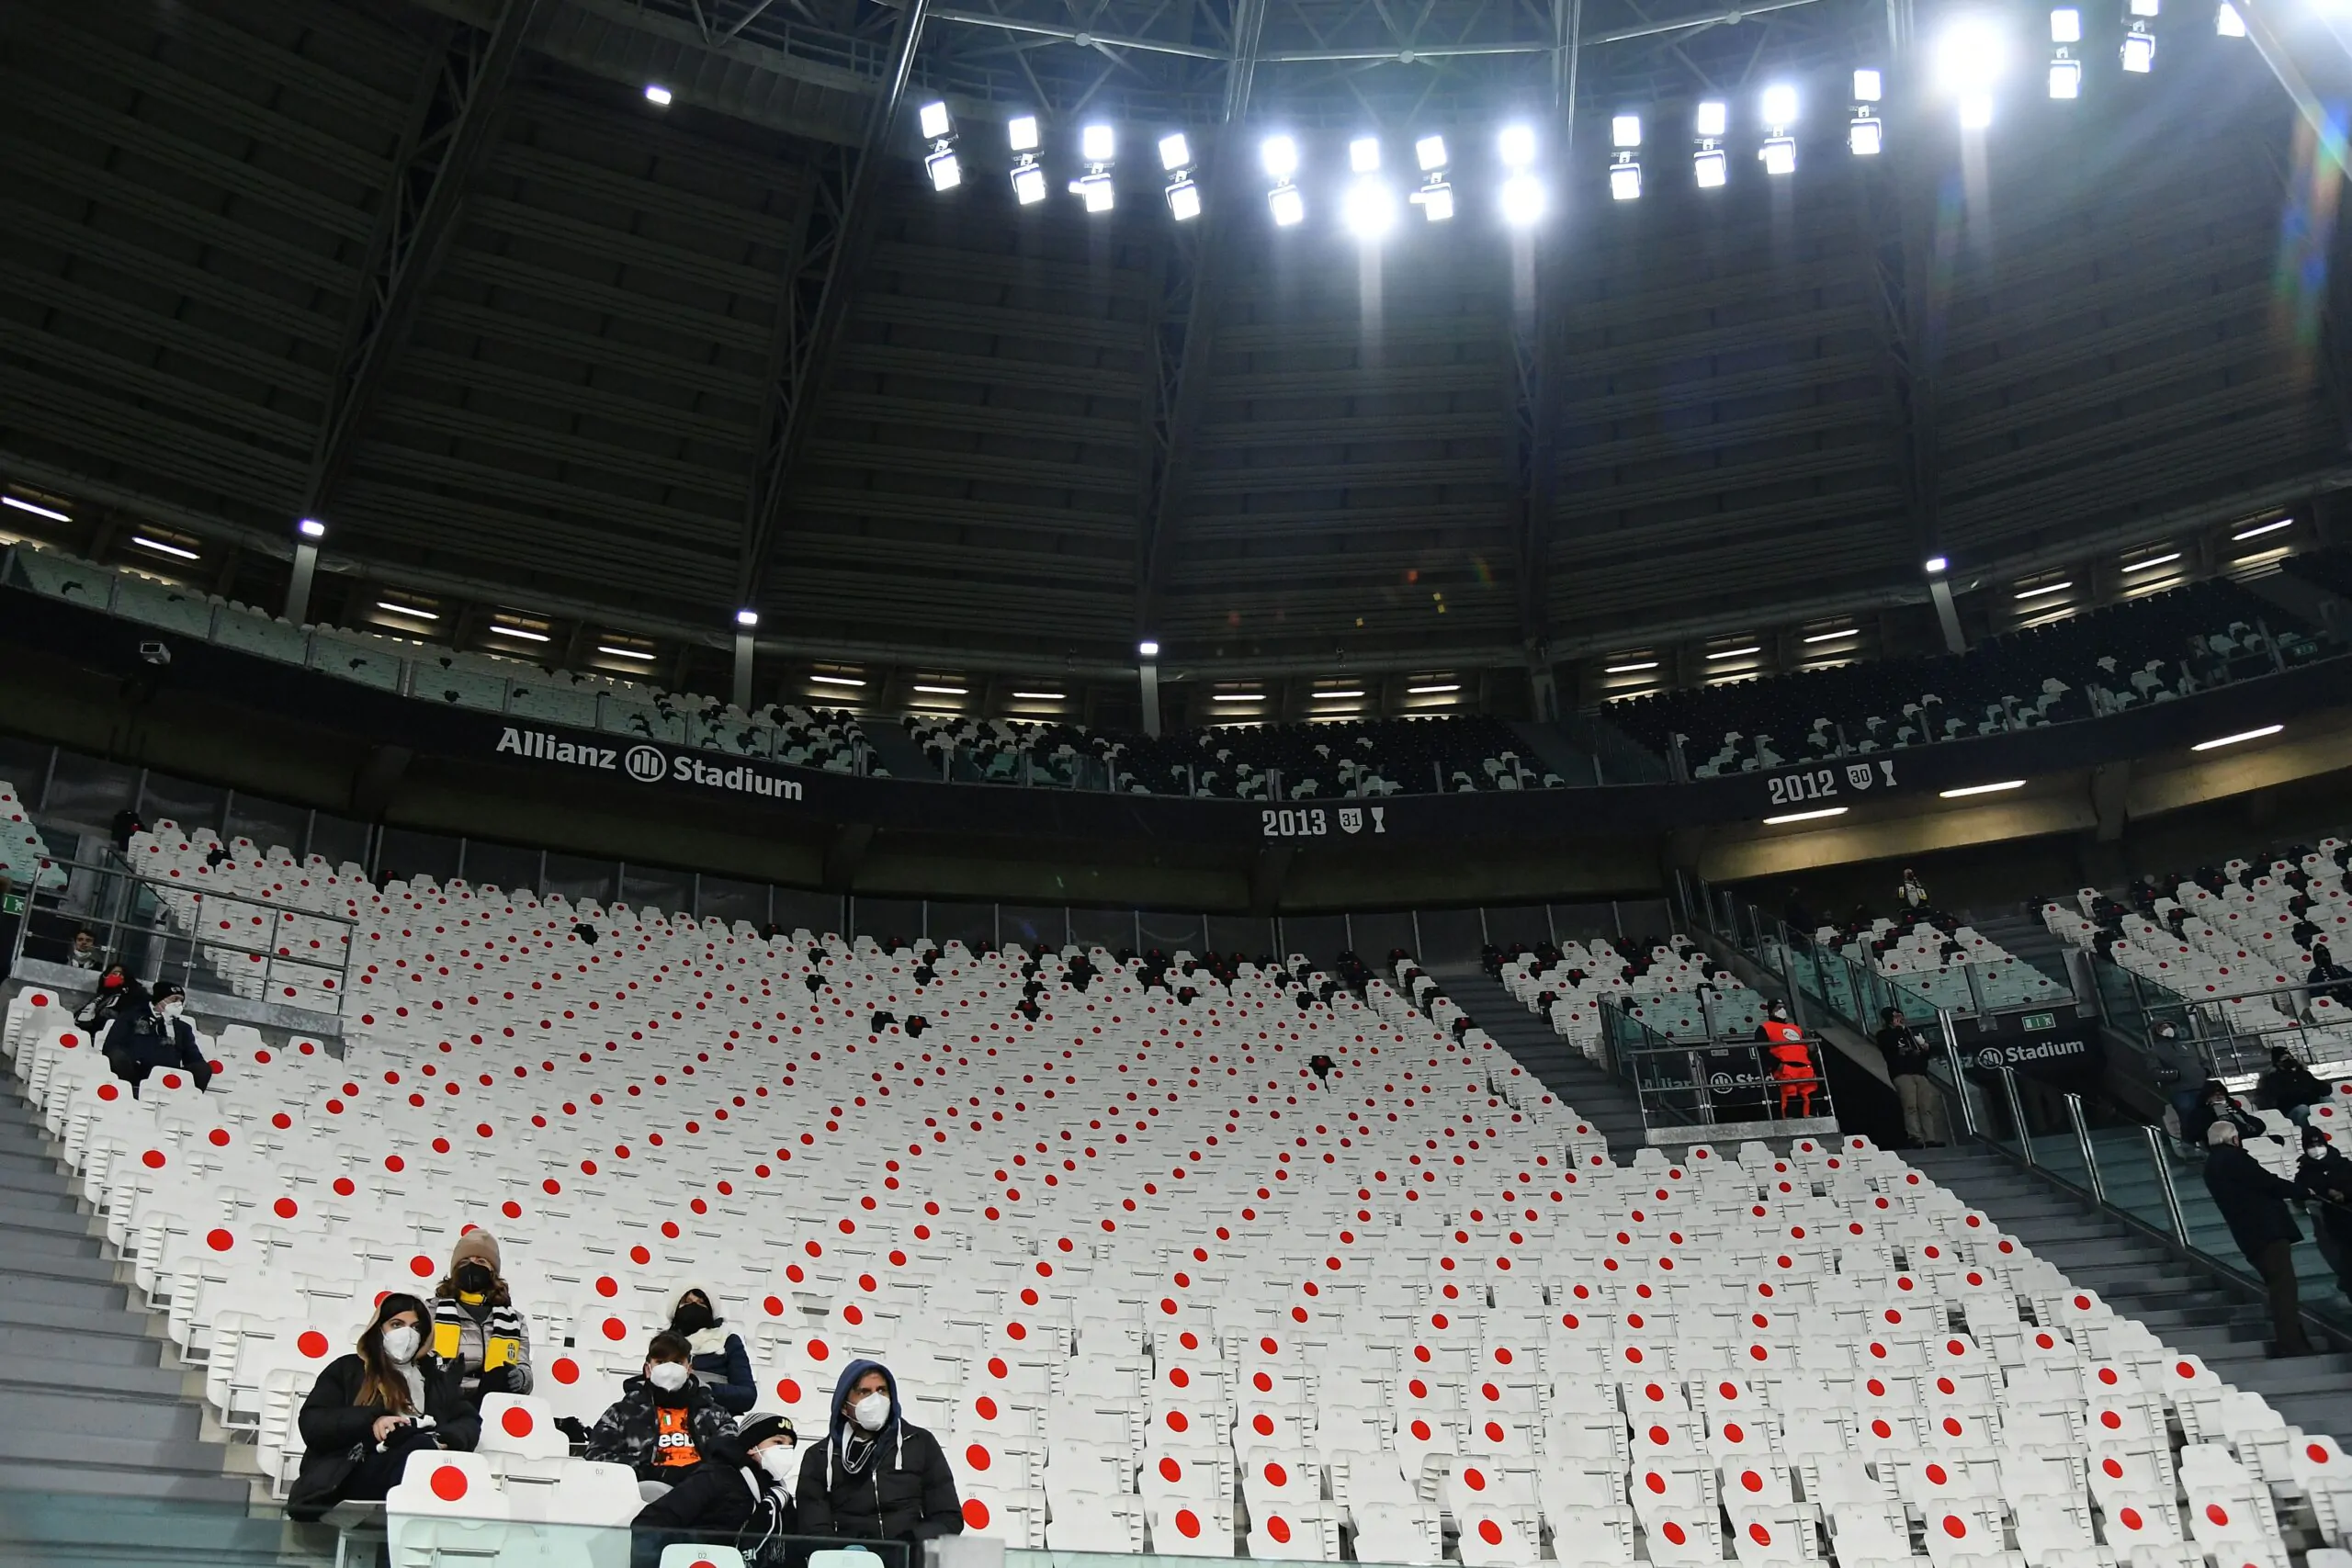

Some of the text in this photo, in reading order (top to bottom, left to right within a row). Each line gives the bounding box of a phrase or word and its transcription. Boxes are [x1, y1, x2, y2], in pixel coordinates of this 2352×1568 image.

[496, 727, 803, 801] Allianz Stadium
[1768, 769, 1871, 805] 2012 30
[1261, 808, 1361, 837] 2013 31
[2005, 1040, 2086, 1063] Stadium
